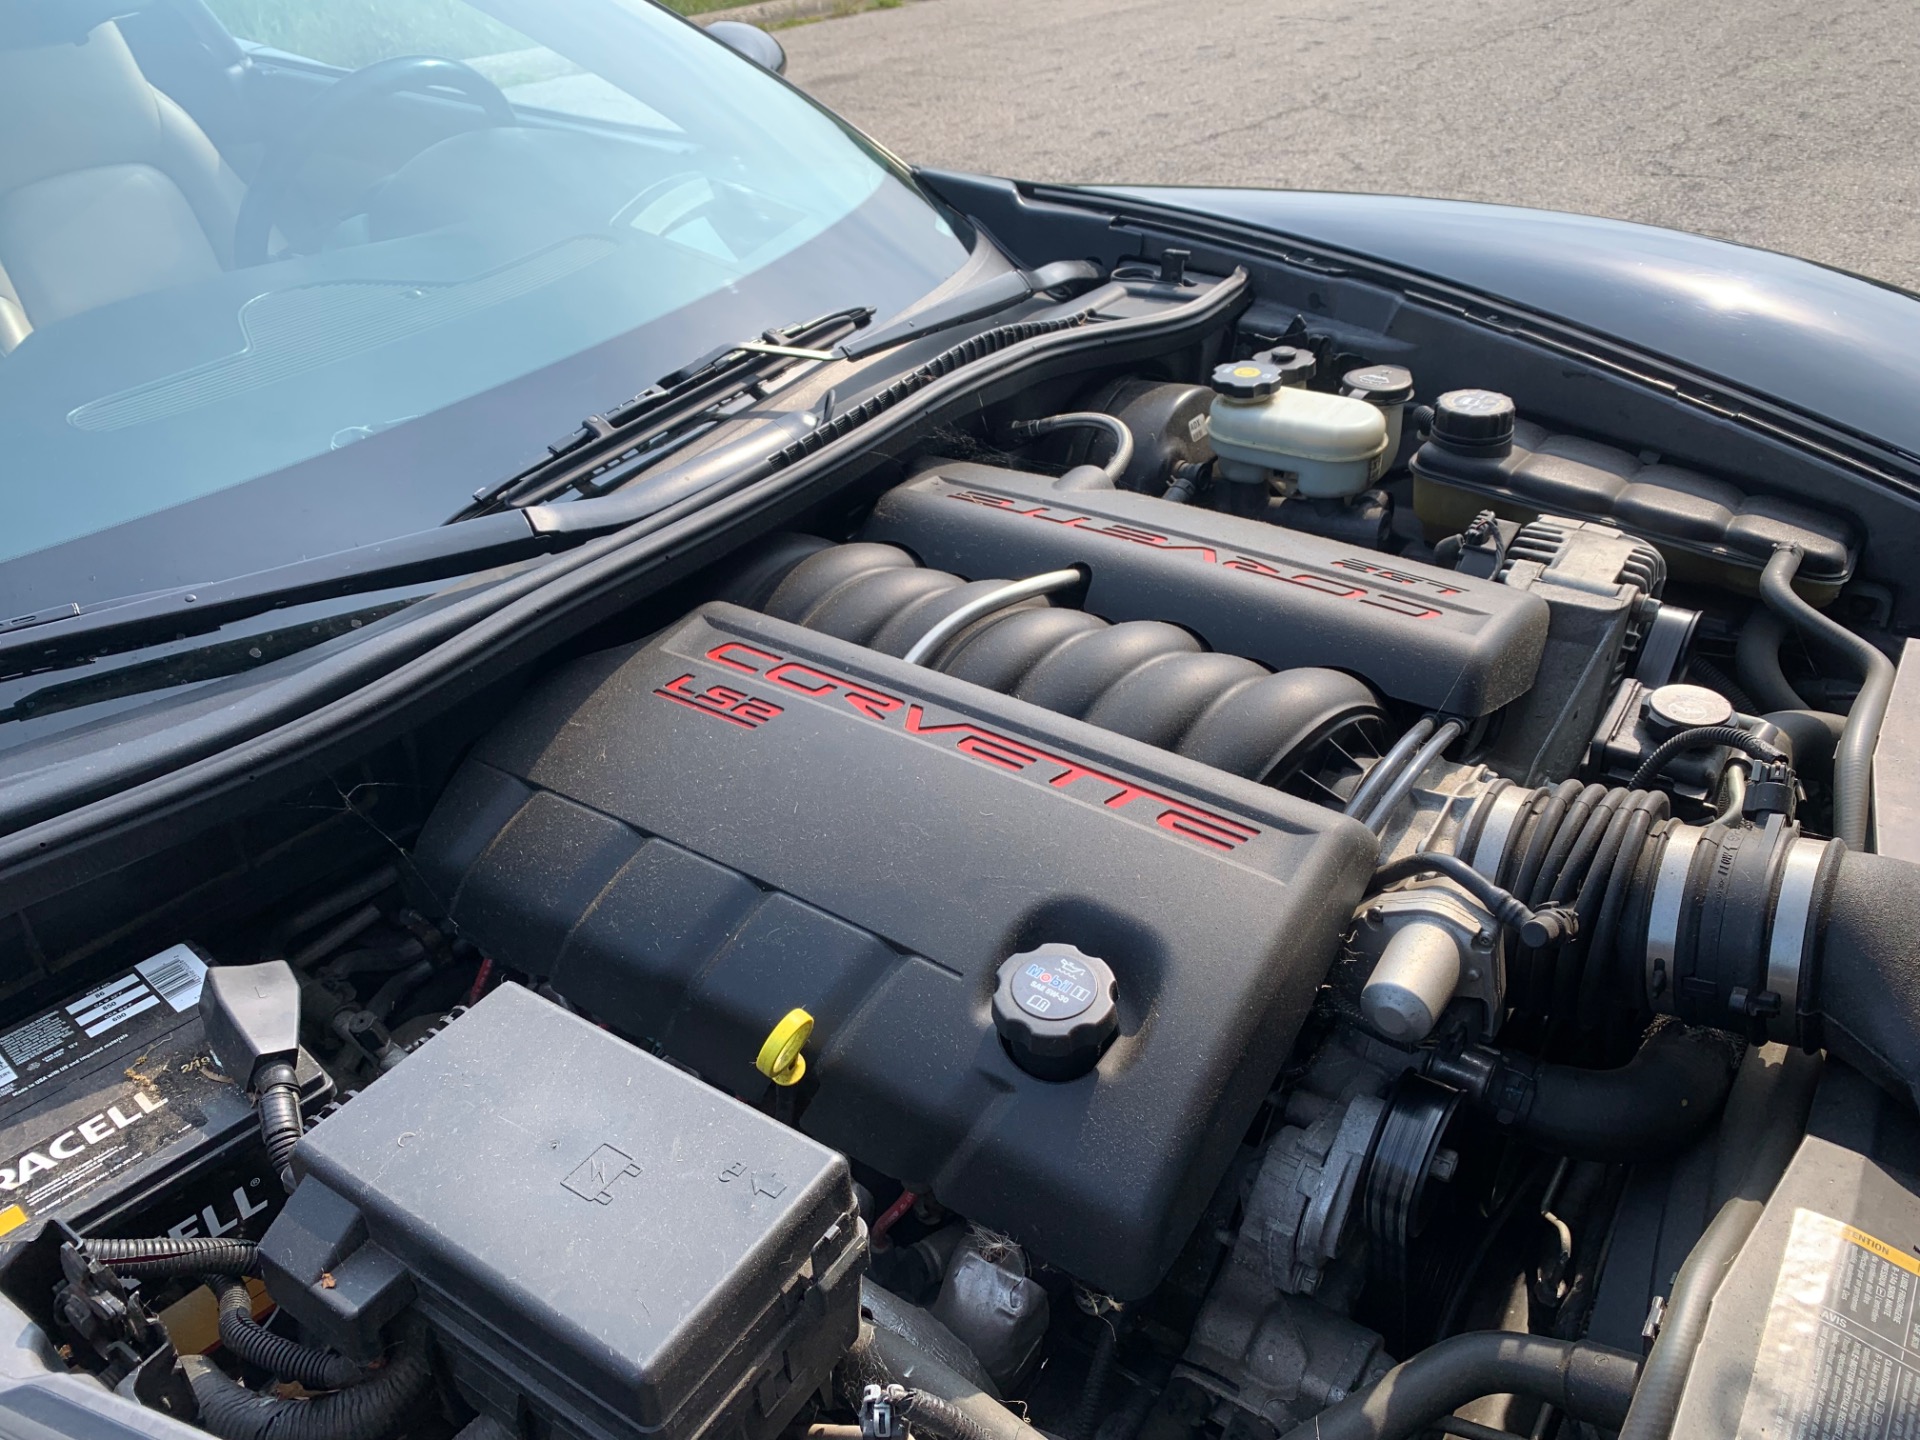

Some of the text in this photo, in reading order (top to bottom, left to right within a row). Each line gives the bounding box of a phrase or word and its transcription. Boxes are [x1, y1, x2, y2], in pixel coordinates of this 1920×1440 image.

[946, 490, 1443, 620] CORVETTE
[652, 672, 785, 730] LS2
[705, 641, 1262, 852] CORVETTE
[1025, 963, 1074, 994] Mobil
[112, 1012, 127, 1022] 690
[12, 1087, 28, 1097] Made
[35, 1076, 48, 1085] USA
[48, 1070, 60, 1078] with
[69, 1059, 80, 1067] and
[80, 1046, 103, 1062] imported
[104, 1034, 128, 1048] materials
[1821, 1310, 1847, 1328] AVIS
[1846, 1341, 1862, 1384] HUILE-MOTEUR
[1834, 1410, 1847, 1438] REQUISE
